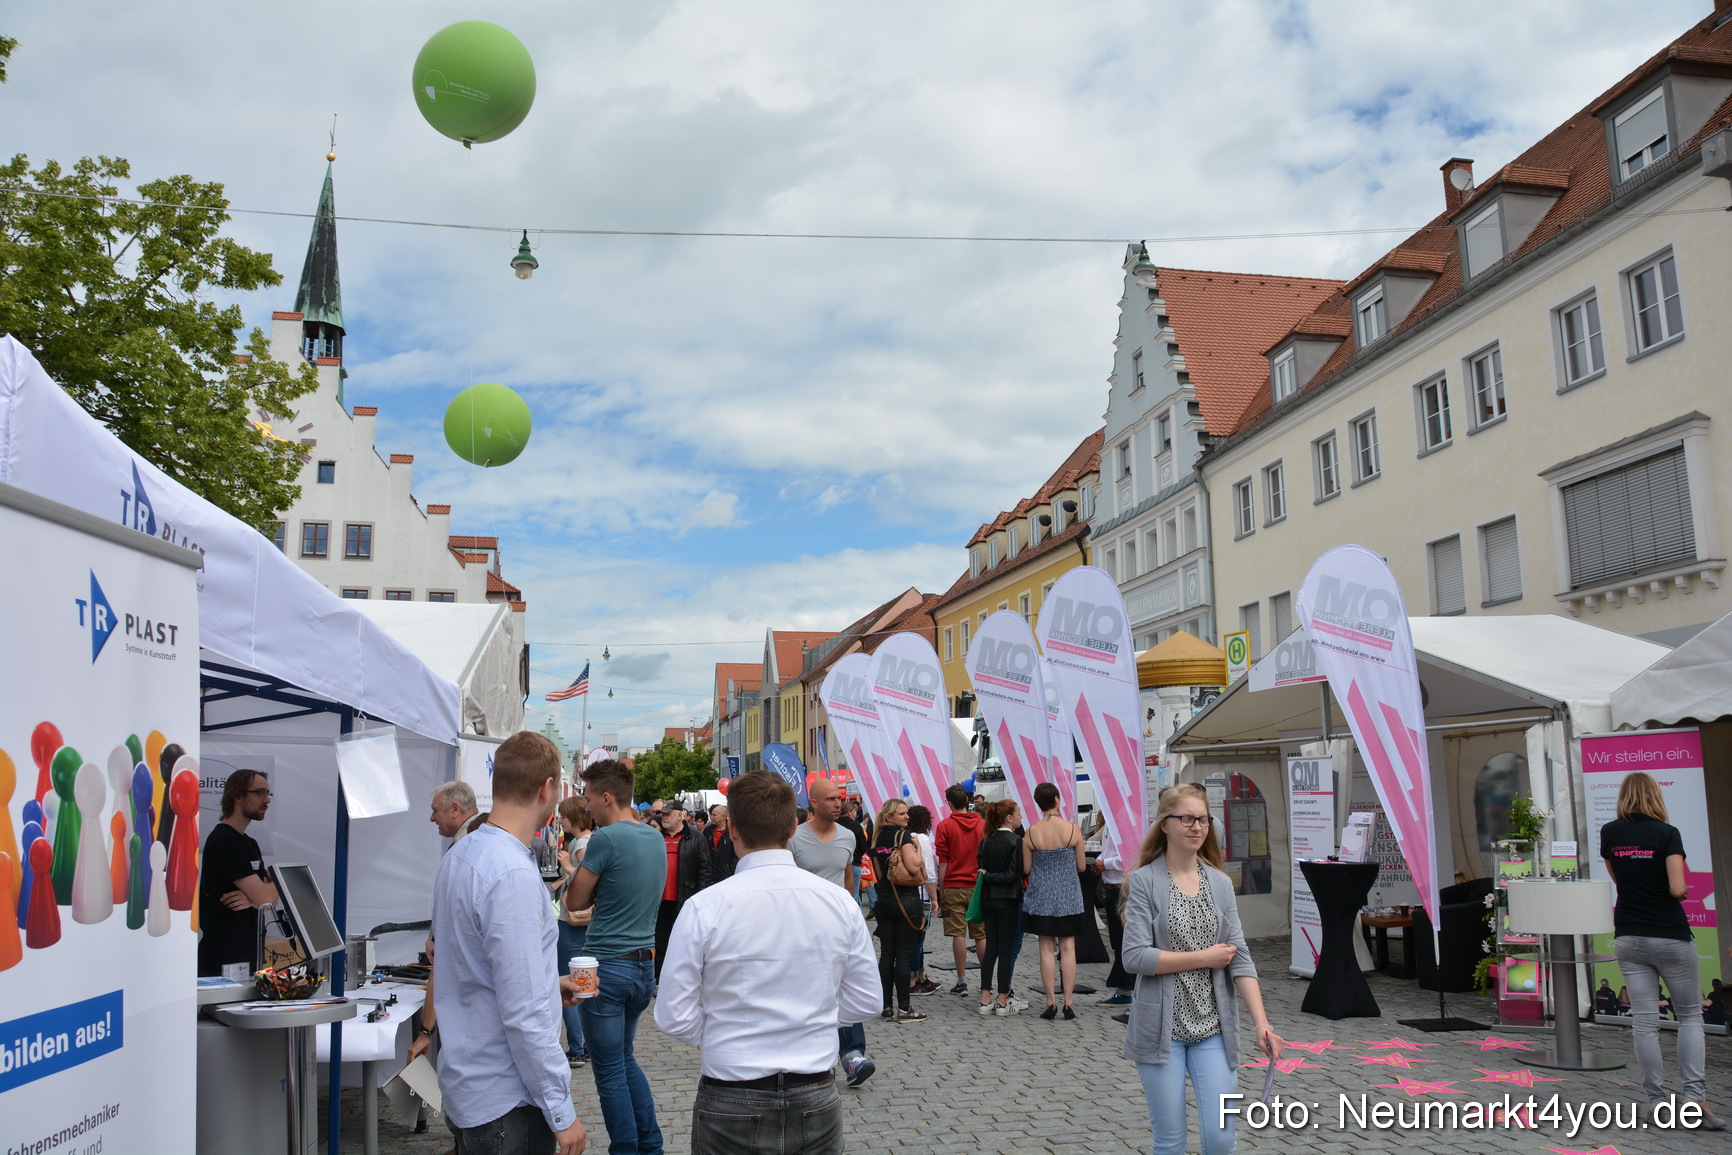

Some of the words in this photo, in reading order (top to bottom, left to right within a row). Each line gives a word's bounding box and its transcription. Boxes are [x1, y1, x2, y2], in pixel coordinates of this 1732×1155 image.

[1152, 586, 1177, 609] WEBER
[75, 598, 109, 632] TR
[125, 612, 178, 646] PLAST
[126, 643, 143, 656] Systeme
[144, 648, 148, 656] in
[149, 650, 176, 661] Kunststoff
[1275, 640, 1316, 672] OM
[1588, 752, 1612, 764] Wir
[1615, 749, 1663, 764] stellen
[1666, 747, 1694, 760] ein.
[198, 776, 226, 788] alitä
[1291, 760, 1320, 786] OM
[1590, 782, 1621, 790] guttenbe
[1619, 849, 1654, 858] partner
[1687, 913, 1706, 922] cht!
[0, 1032, 69, 1075] bilden
[75, 1010, 111, 1048] aus!
